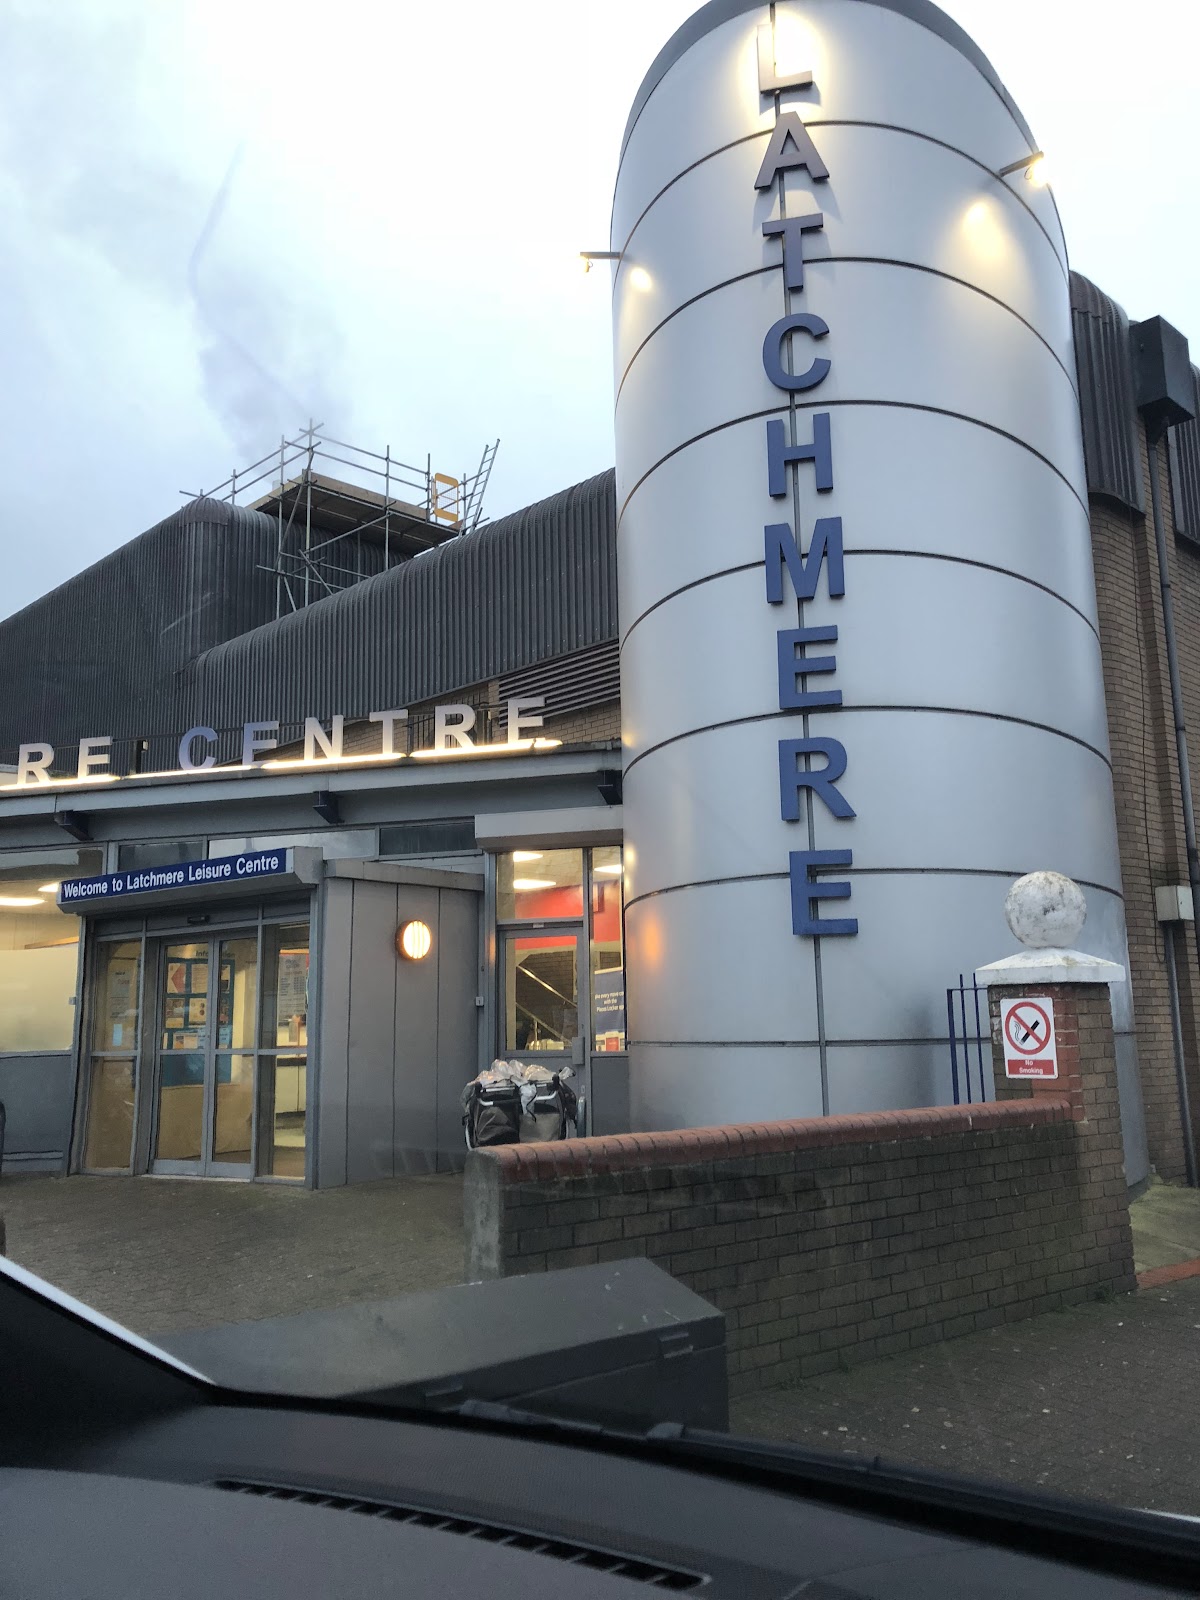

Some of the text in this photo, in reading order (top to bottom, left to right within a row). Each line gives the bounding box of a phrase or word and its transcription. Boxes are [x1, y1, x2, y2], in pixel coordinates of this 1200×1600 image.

[754, 24, 858, 936] LATCHMERE
[17, 696, 548, 785] RE CENTRE
[64, 855, 279, 898] Welcome to Latchmere Leisure Centre
